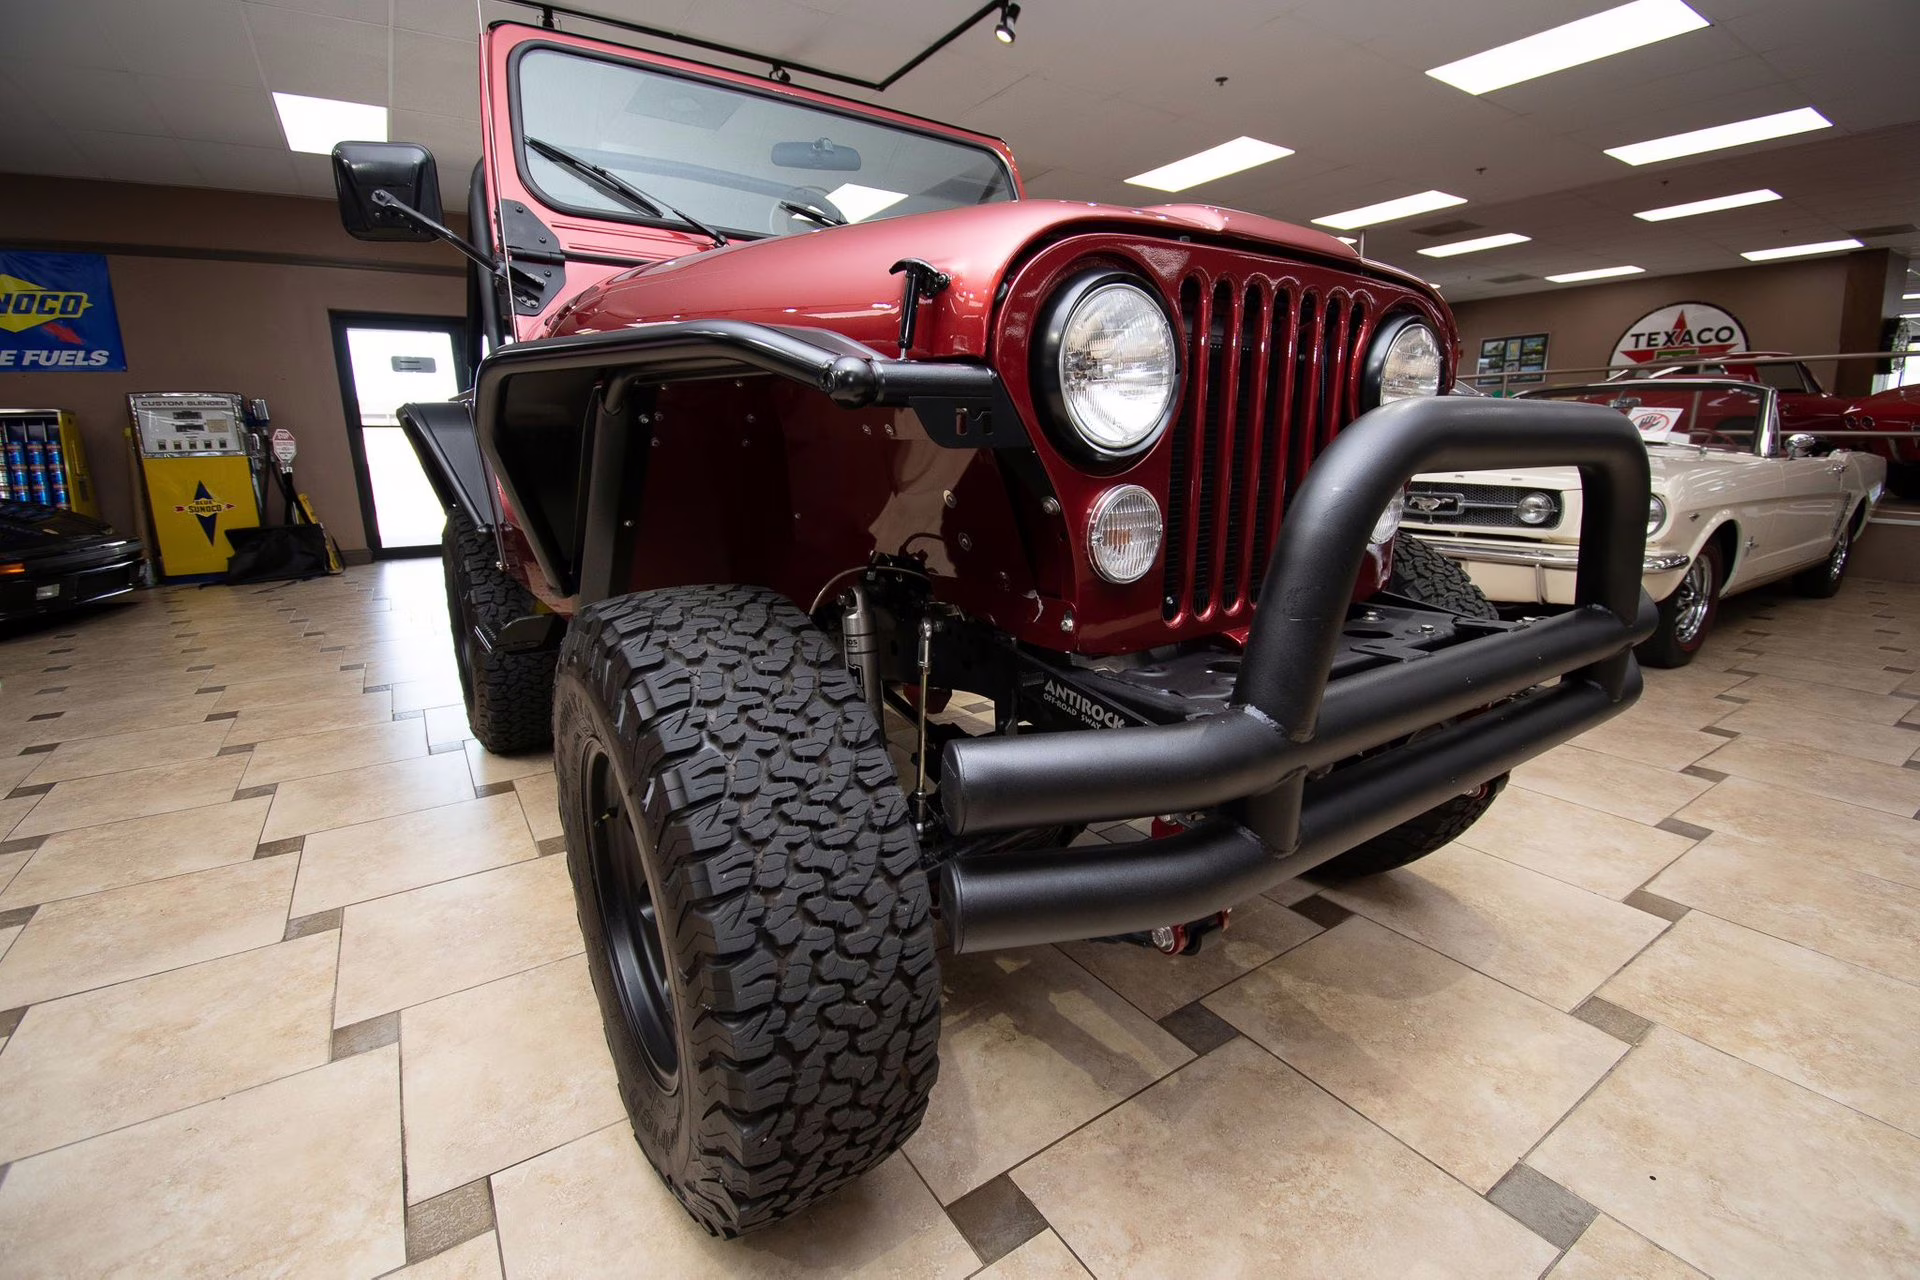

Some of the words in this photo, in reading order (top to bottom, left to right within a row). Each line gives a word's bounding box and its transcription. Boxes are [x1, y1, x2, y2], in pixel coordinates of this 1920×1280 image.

[1630, 325, 1735, 349] TEXACO
[22, 349, 110, 366] FUELS
[188, 504, 222, 513] SUNOCO
[1043, 692, 1077, 716] OFF-ROAD
[1081, 714, 1101, 730] SWAY
[1044, 679, 1125, 729] ANTIROCK
